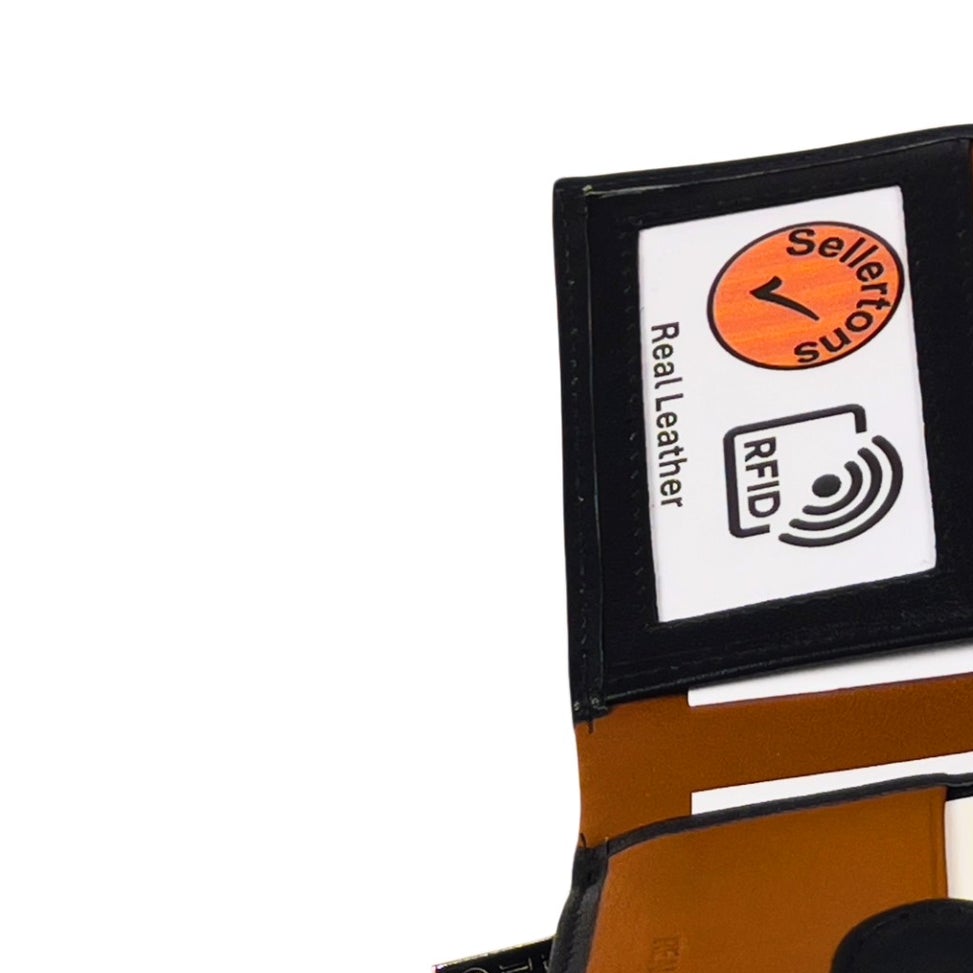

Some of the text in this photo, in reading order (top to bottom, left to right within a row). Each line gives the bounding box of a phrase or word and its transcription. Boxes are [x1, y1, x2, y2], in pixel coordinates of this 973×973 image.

[785, 228, 891, 364] Sellertons
[650, 320, 690, 508] Real Leather
[743, 437, 782, 519] RFID
